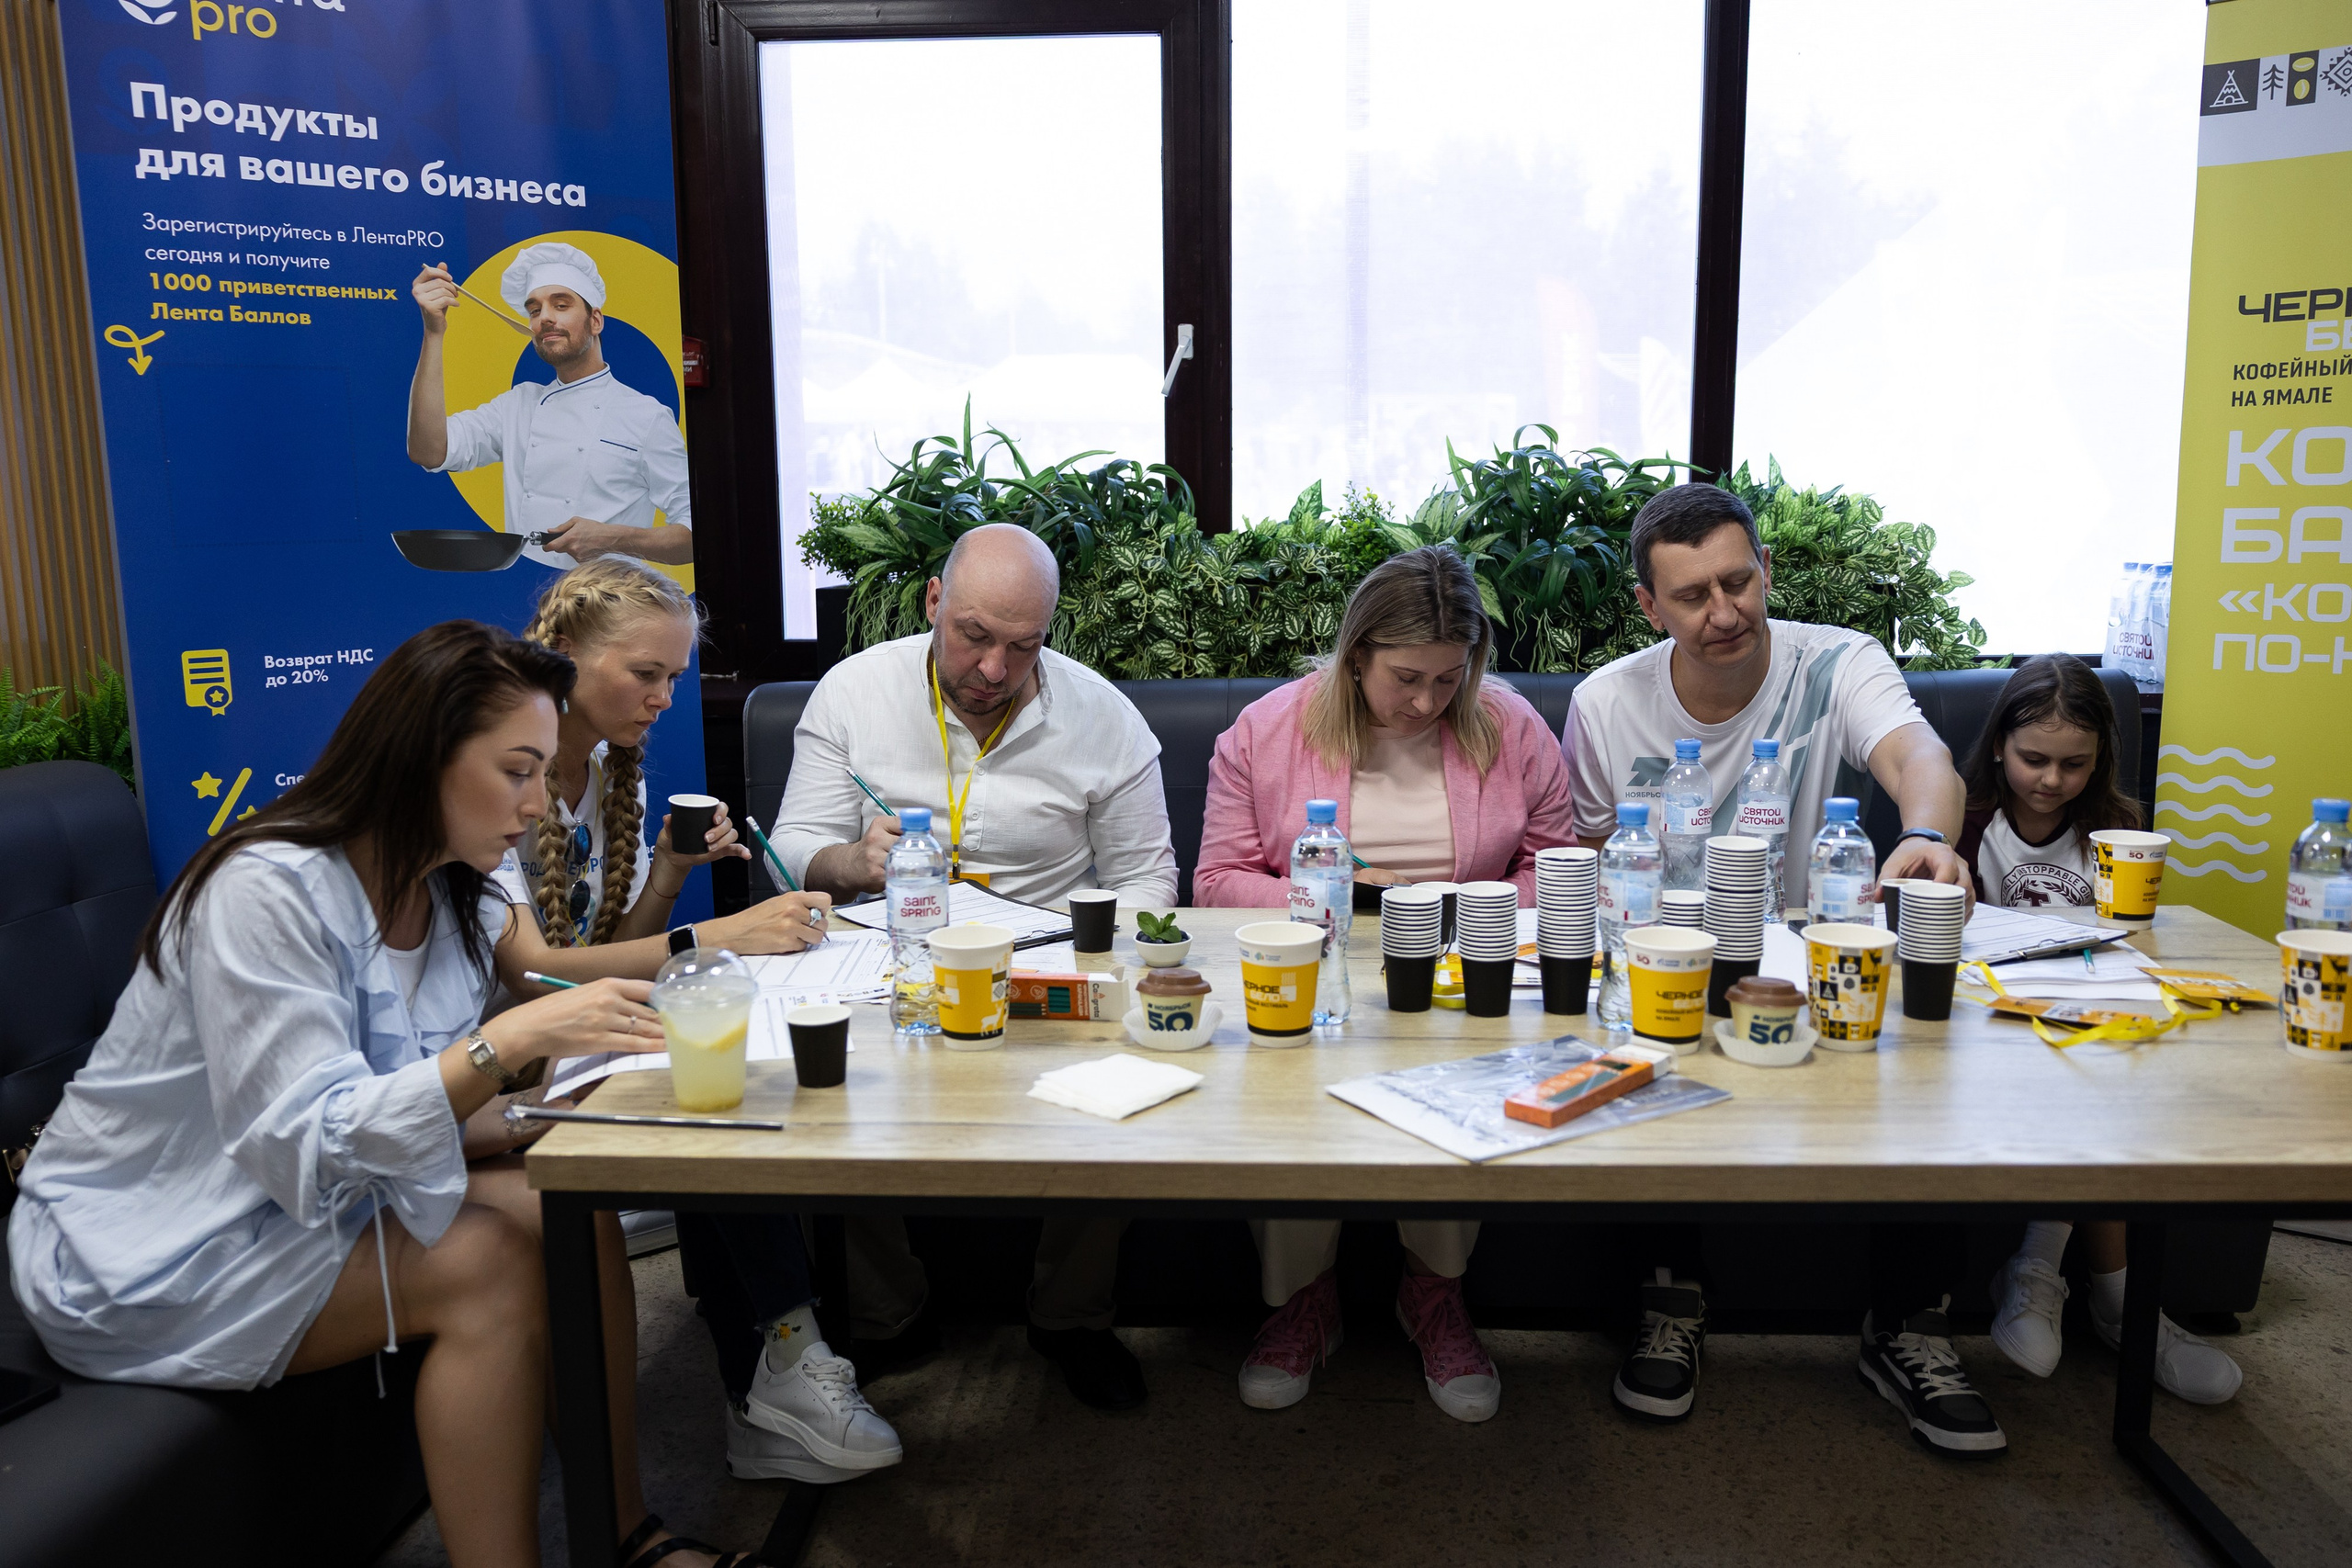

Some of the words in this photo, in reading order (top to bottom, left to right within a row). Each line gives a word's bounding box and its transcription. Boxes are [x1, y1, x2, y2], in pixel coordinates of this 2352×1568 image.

[189, 0, 277, 40] pro
[130, 81, 379, 141] Продукты
[135, 148, 226, 181] для
[239, 155, 410, 193] вашего
[420, 160, 587, 208] бизнеса
[141, 211, 332, 243] Зарегистрируйтесь
[337, 228, 347, 242] в
[352, 226, 445, 248] ЛентаPRO
[144, 247, 223, 264] сегодня
[228, 251, 241, 264] и
[245, 251, 331, 272] получите
[150, 272, 211, 291] 1000
[219, 278, 399, 301] приветственных
[151, 302, 224, 321] Лента
[229, 305, 311, 325] Баллов
[2238, 288, 2352, 322] ЧЕР
[2233, 354, 2352, 381] КОФЕЙНЫЙ
[2231, 390, 2257, 407] НА
[2261, 387, 2334, 406] ЯМАЛЕ
[264, 653, 334, 669] Возврат
[336, 649, 374, 665] НДС
[265, 674, 288, 688] до
[291, 669, 329, 683] 20%
[1624, 791, 1662, 799] НОЯБРЬС
[1738, 814, 1785, 826] ИСТОЧНИК
[1743, 807, 1781, 817] СВЯТОЙ
[1148, 1010, 1193, 1032] 50
[1748, 1021, 1793, 1044] 50
